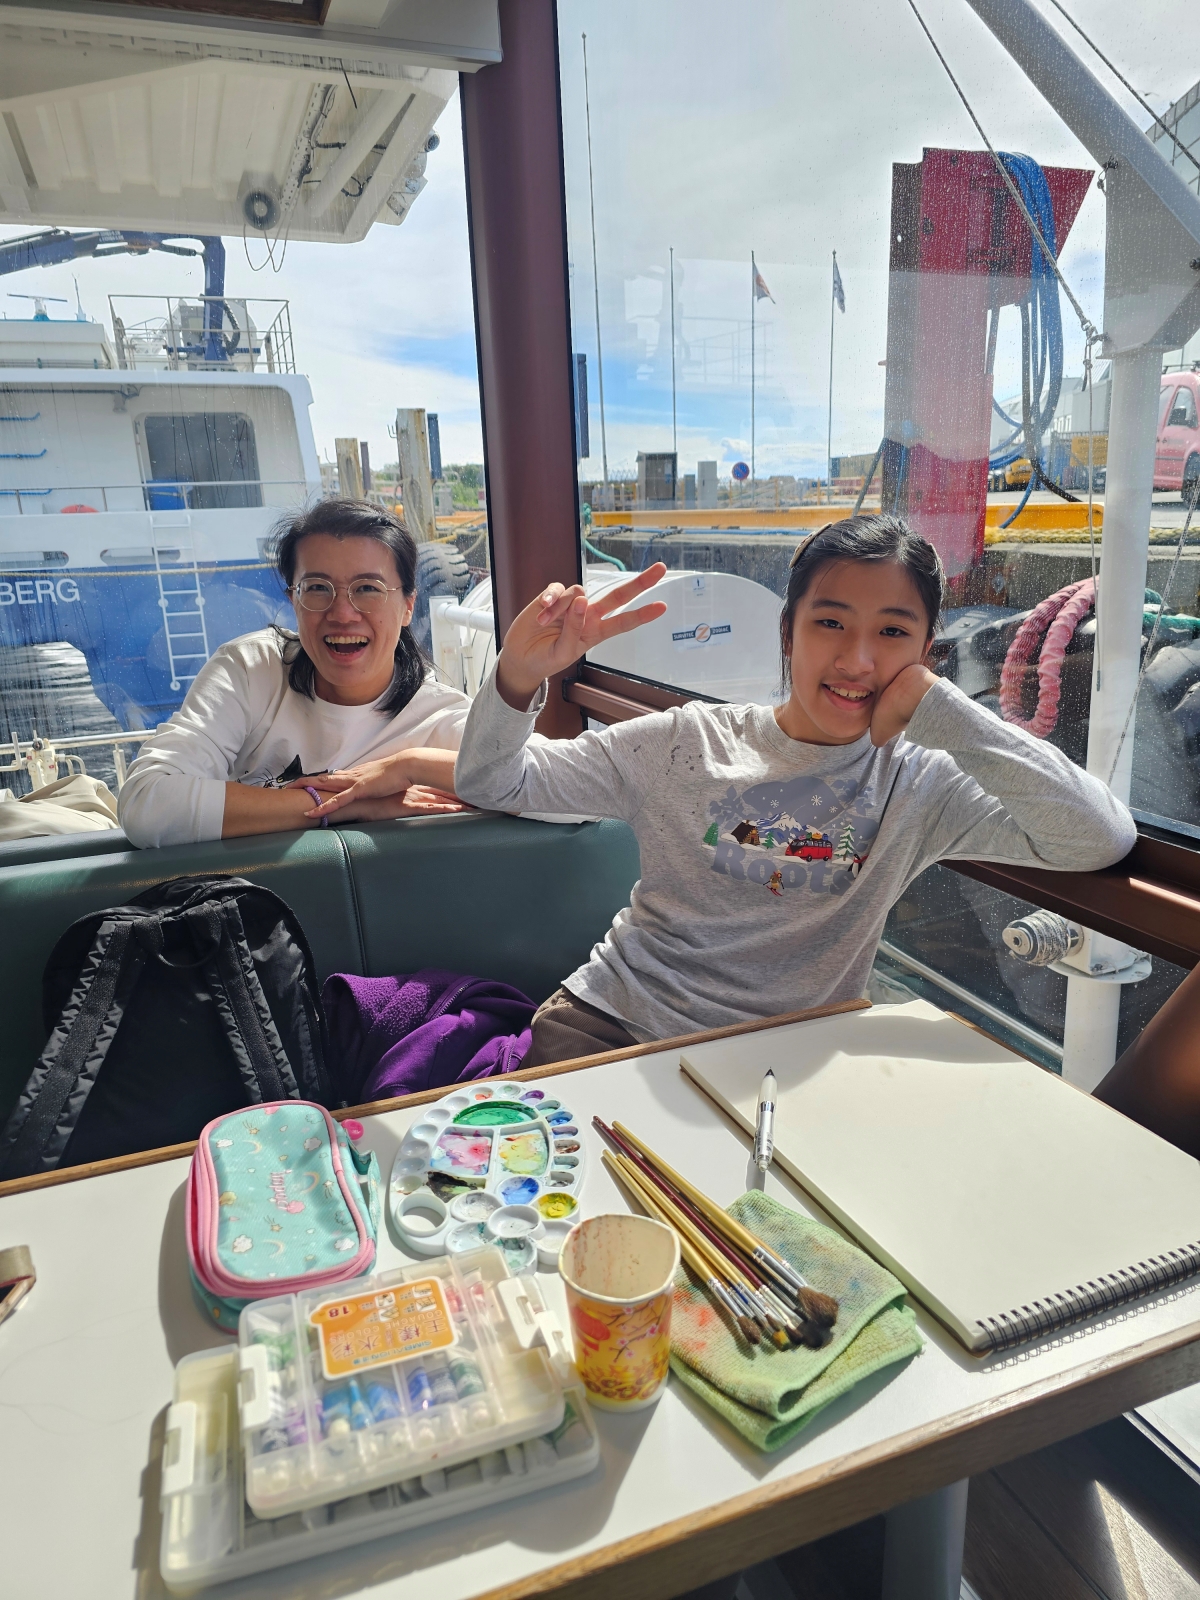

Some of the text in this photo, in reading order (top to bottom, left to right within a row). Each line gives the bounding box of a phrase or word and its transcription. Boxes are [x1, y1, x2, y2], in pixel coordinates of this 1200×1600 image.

[0, 579, 80, 605] BERG
[711, 840, 855, 896] Roots
[329, 1306, 349, 1318] 18
